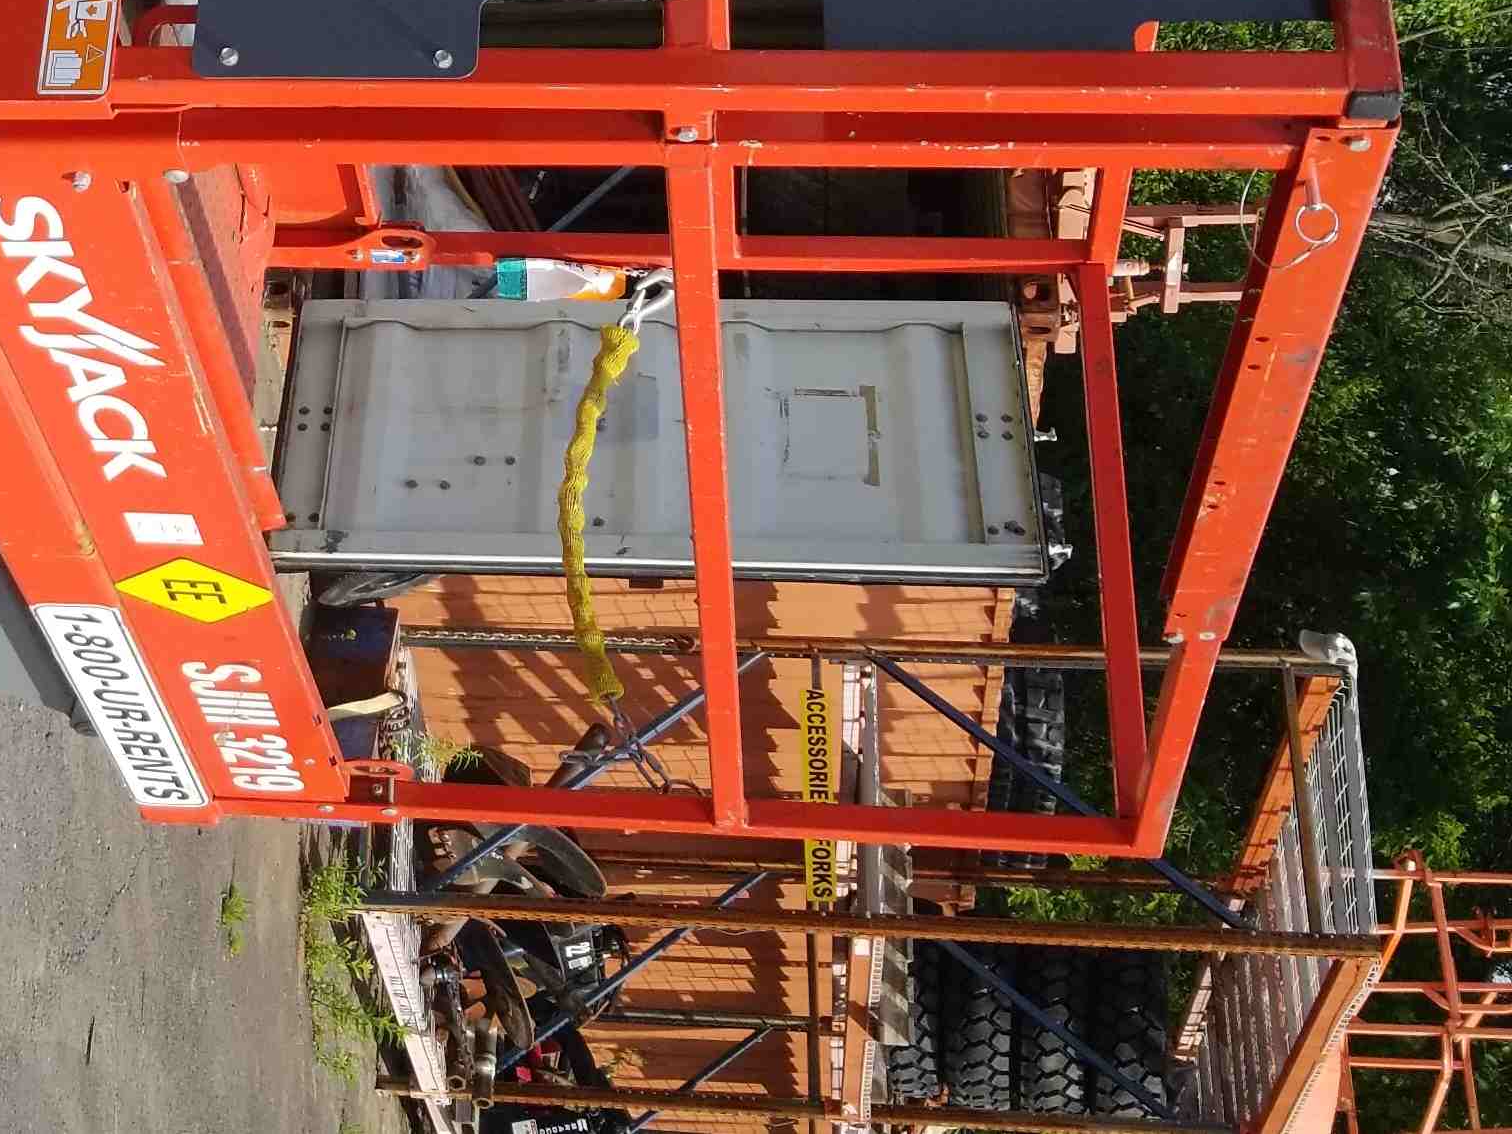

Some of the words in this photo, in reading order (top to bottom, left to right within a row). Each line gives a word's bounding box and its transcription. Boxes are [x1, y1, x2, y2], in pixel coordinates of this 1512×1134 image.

[161, 576, 227, 604] EE
[51, 613, 186, 804] 1-800-UR-RENTS
[806, 689, 829, 802] ACCESSORIE
[213, 732, 305, 794] 3219
